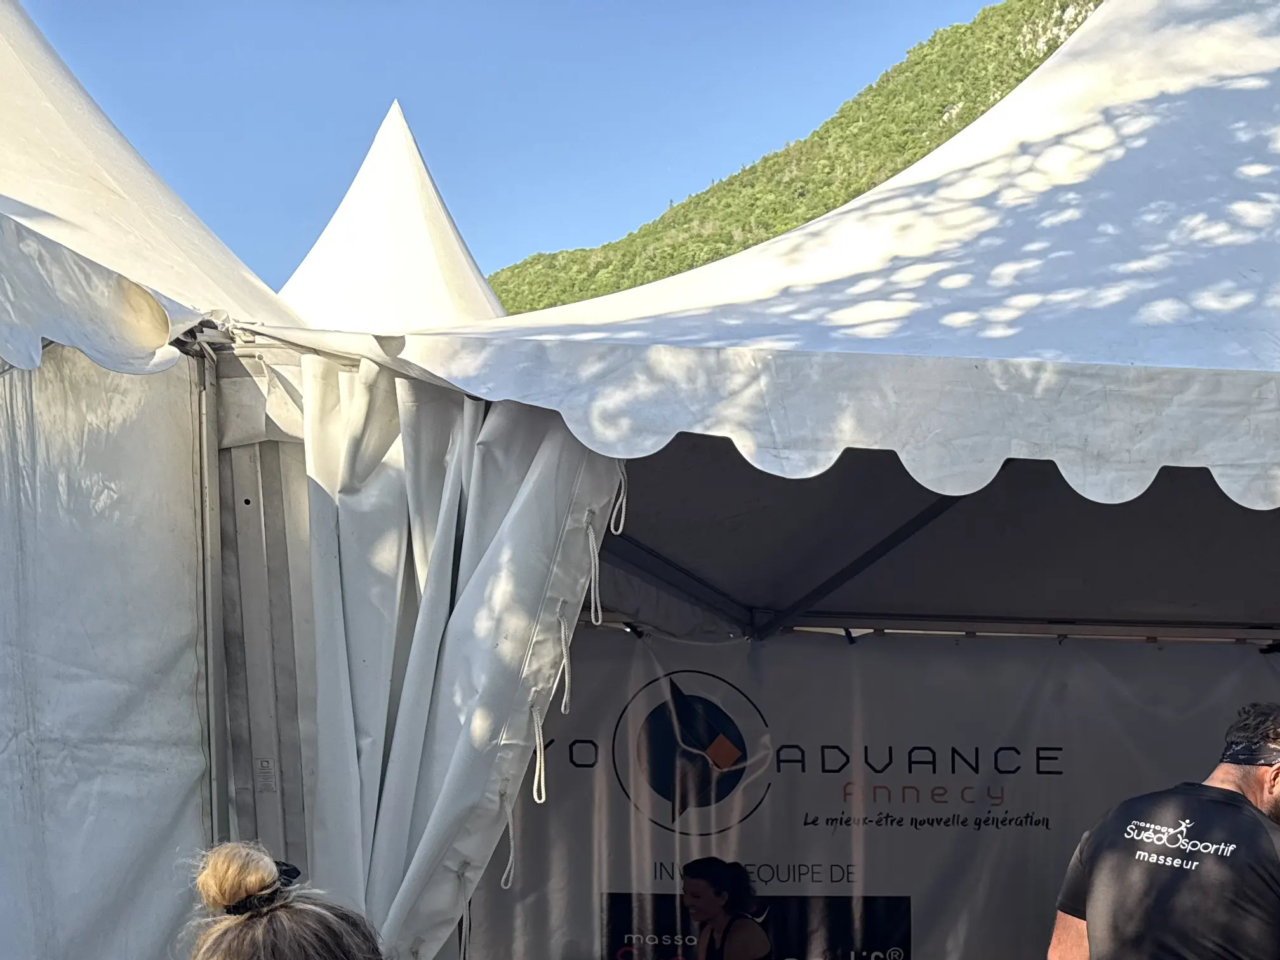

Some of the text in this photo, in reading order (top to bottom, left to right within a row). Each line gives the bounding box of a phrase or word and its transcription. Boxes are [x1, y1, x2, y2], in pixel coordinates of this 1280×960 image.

[776, 745, 1064, 775] ADVANCE
[803, 813, 819, 826] Le
[910, 814, 968, 830] nouvelle
[975, 810, 1052, 830] génération
[1135, 850, 1199, 871] masseur
[831, 864, 857, 883] DE
[624, 934, 698, 946] massa
